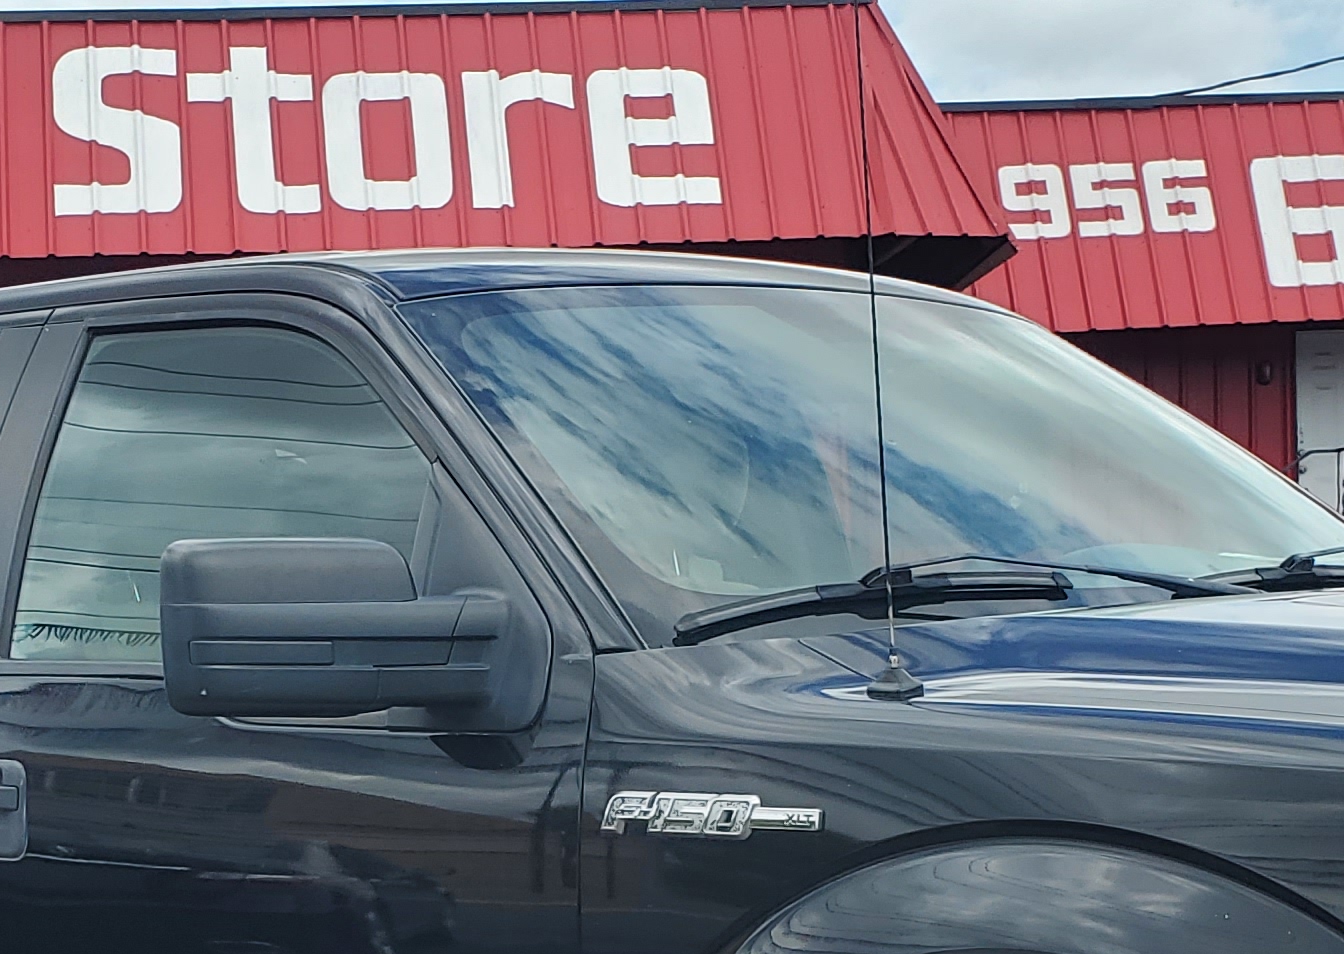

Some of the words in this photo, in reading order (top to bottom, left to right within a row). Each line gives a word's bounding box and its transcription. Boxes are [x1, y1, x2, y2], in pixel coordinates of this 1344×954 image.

[52, 44, 724, 218] Store
[996, 157, 1217, 241] 956
[783, 812, 814, 826] XLT
